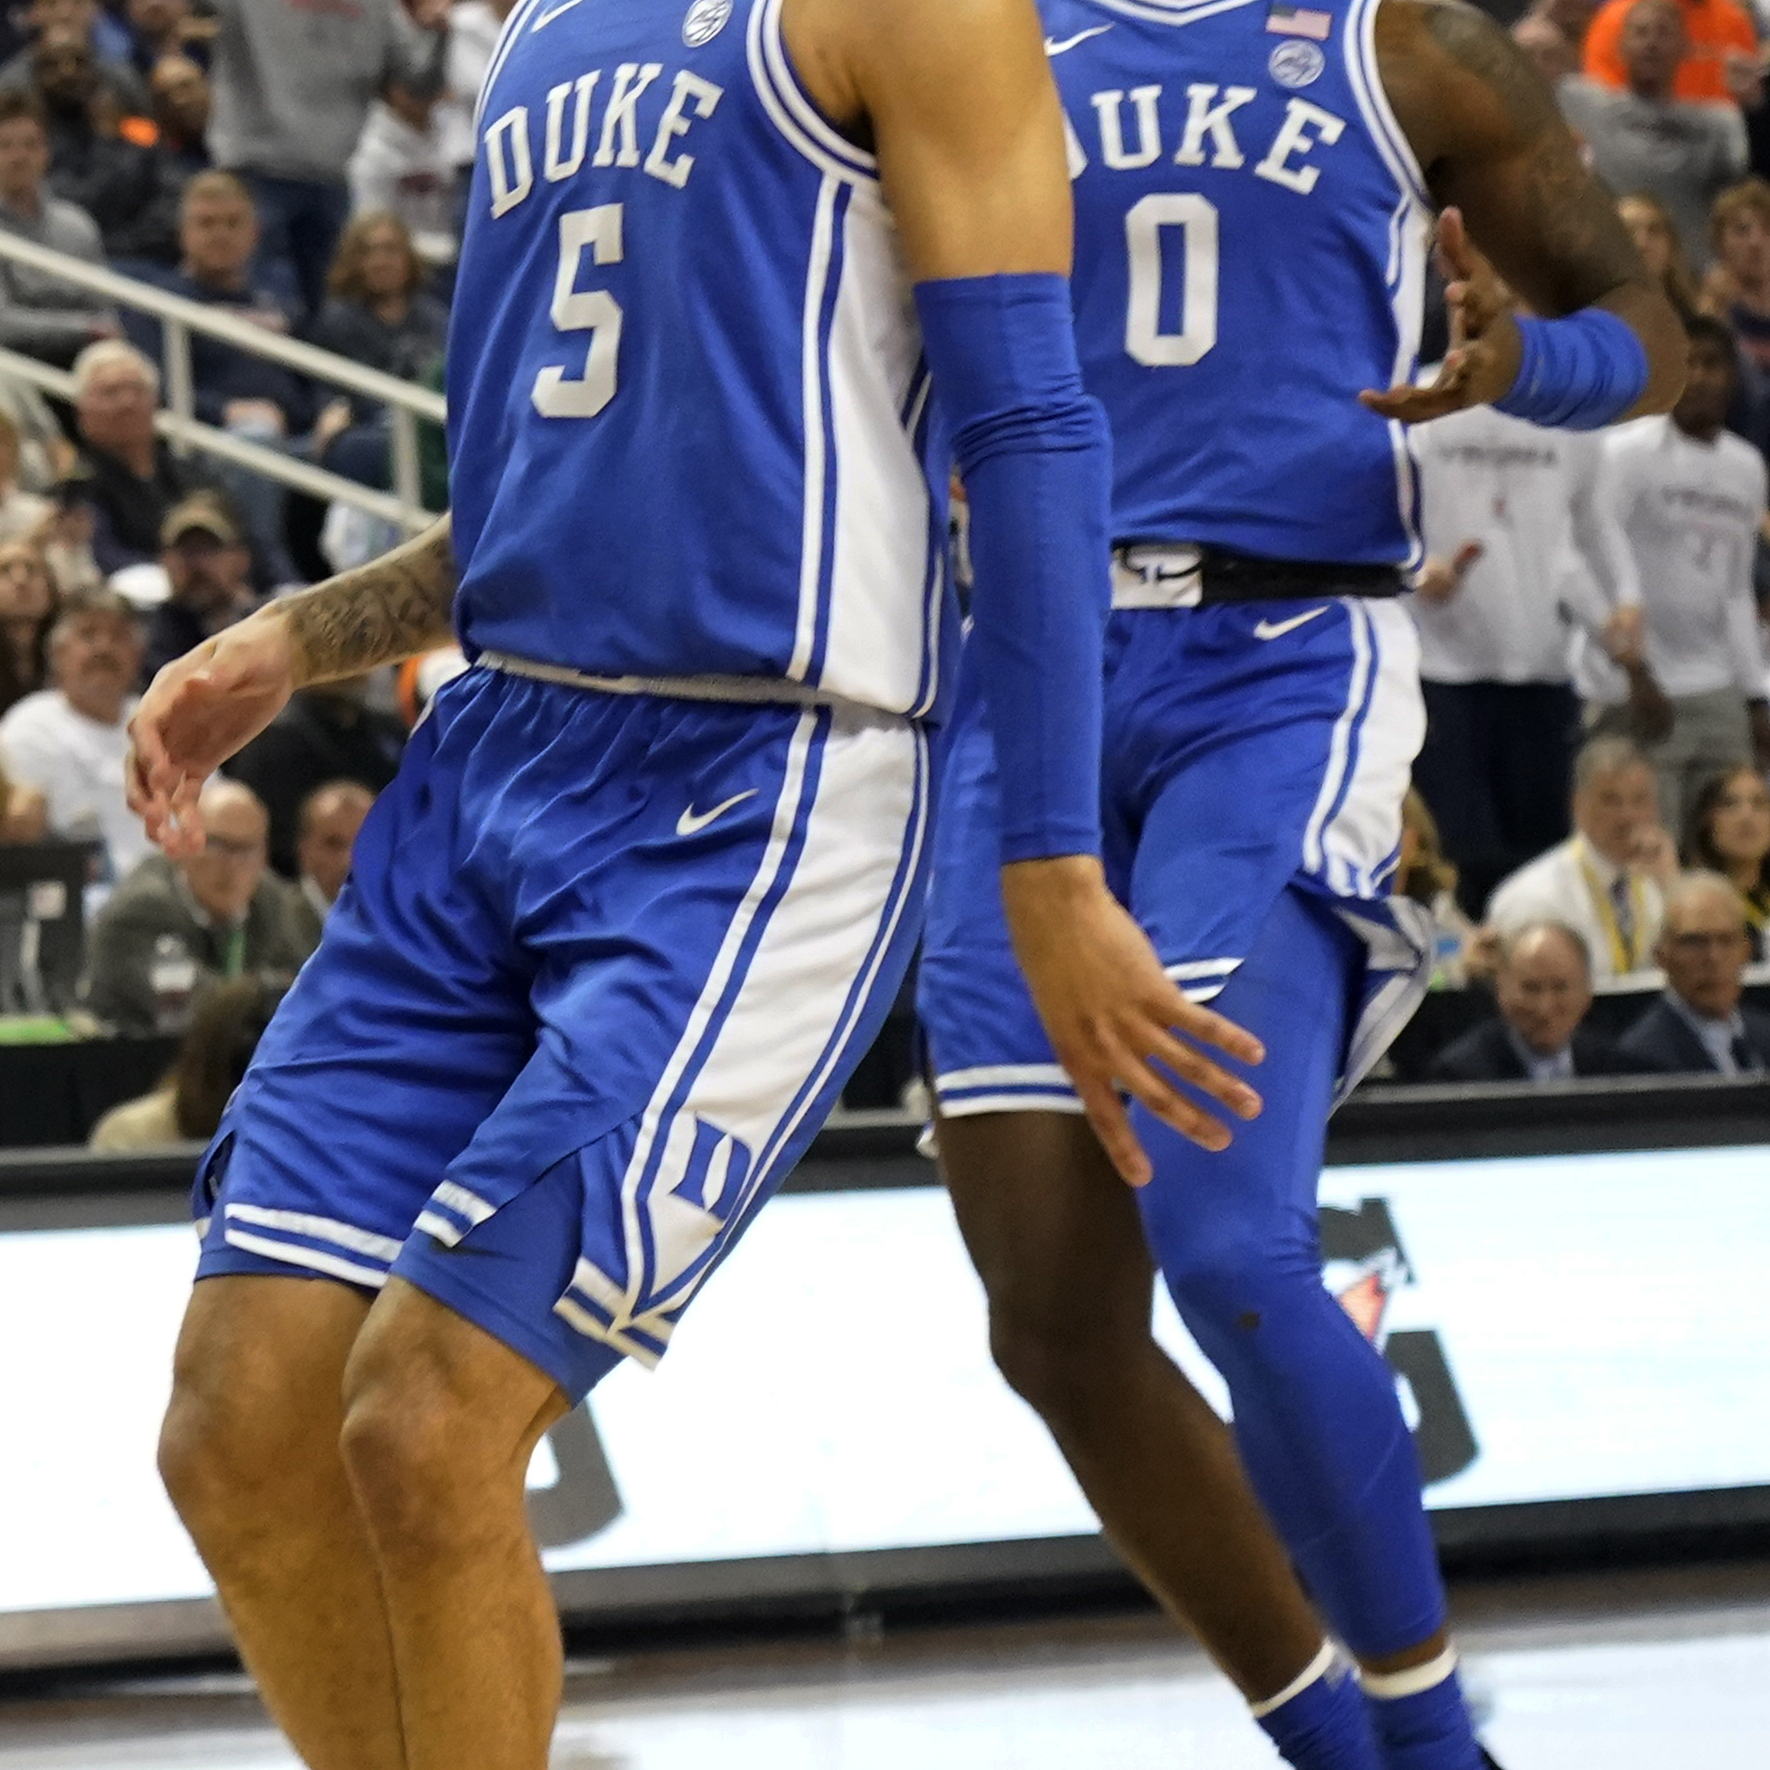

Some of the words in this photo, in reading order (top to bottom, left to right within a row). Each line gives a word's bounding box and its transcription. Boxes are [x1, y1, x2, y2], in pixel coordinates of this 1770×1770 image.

[484, 62, 724, 220] DUKE
[1068, 83, 1347, 195] UKE
[530, 202, 624, 419] 5
[1124, 192, 1220, 368] 0
